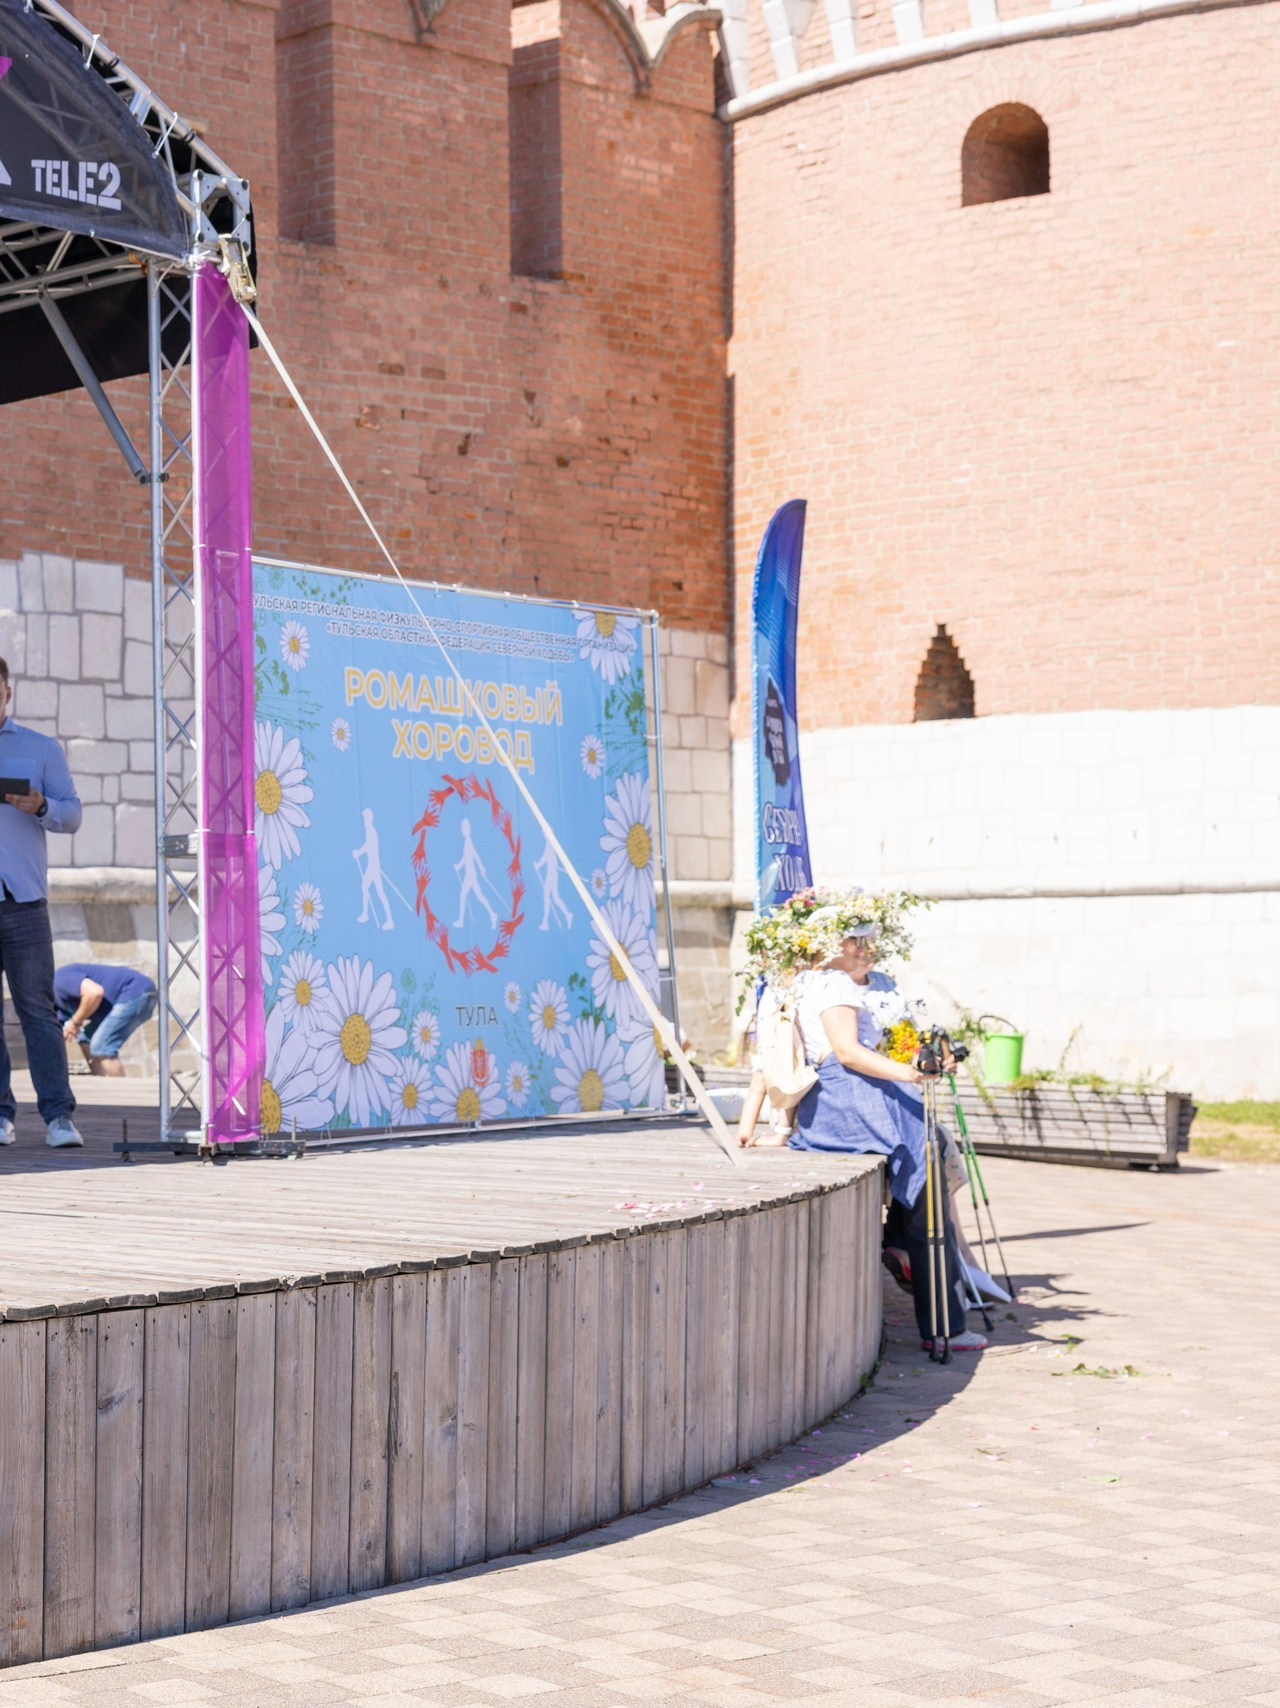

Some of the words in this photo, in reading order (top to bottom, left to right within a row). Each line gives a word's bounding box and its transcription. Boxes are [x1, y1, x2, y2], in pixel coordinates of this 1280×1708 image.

[31, 159, 122, 211] TELE2
[253, 594, 298, 611] УЛЬСКАЯ
[301, 601, 376, 621] РЕГИОНАЛЬНАЯ
[510, 629, 576, 646] ОБЩЕСТВЕННАЯ
[327, 622, 379, 637] «ТУЛЬСКАЯ
[439, 636, 490, 652] ФЕДЕРАЦИЯ
[492, 642, 535, 657] СЕВЕРНОЙ
[345, 667, 563, 725] РОМАШКОВЫЙ
[392, 719, 535, 775] ХОРОВОД
[455, 1006, 499, 1026] ТУЛА
